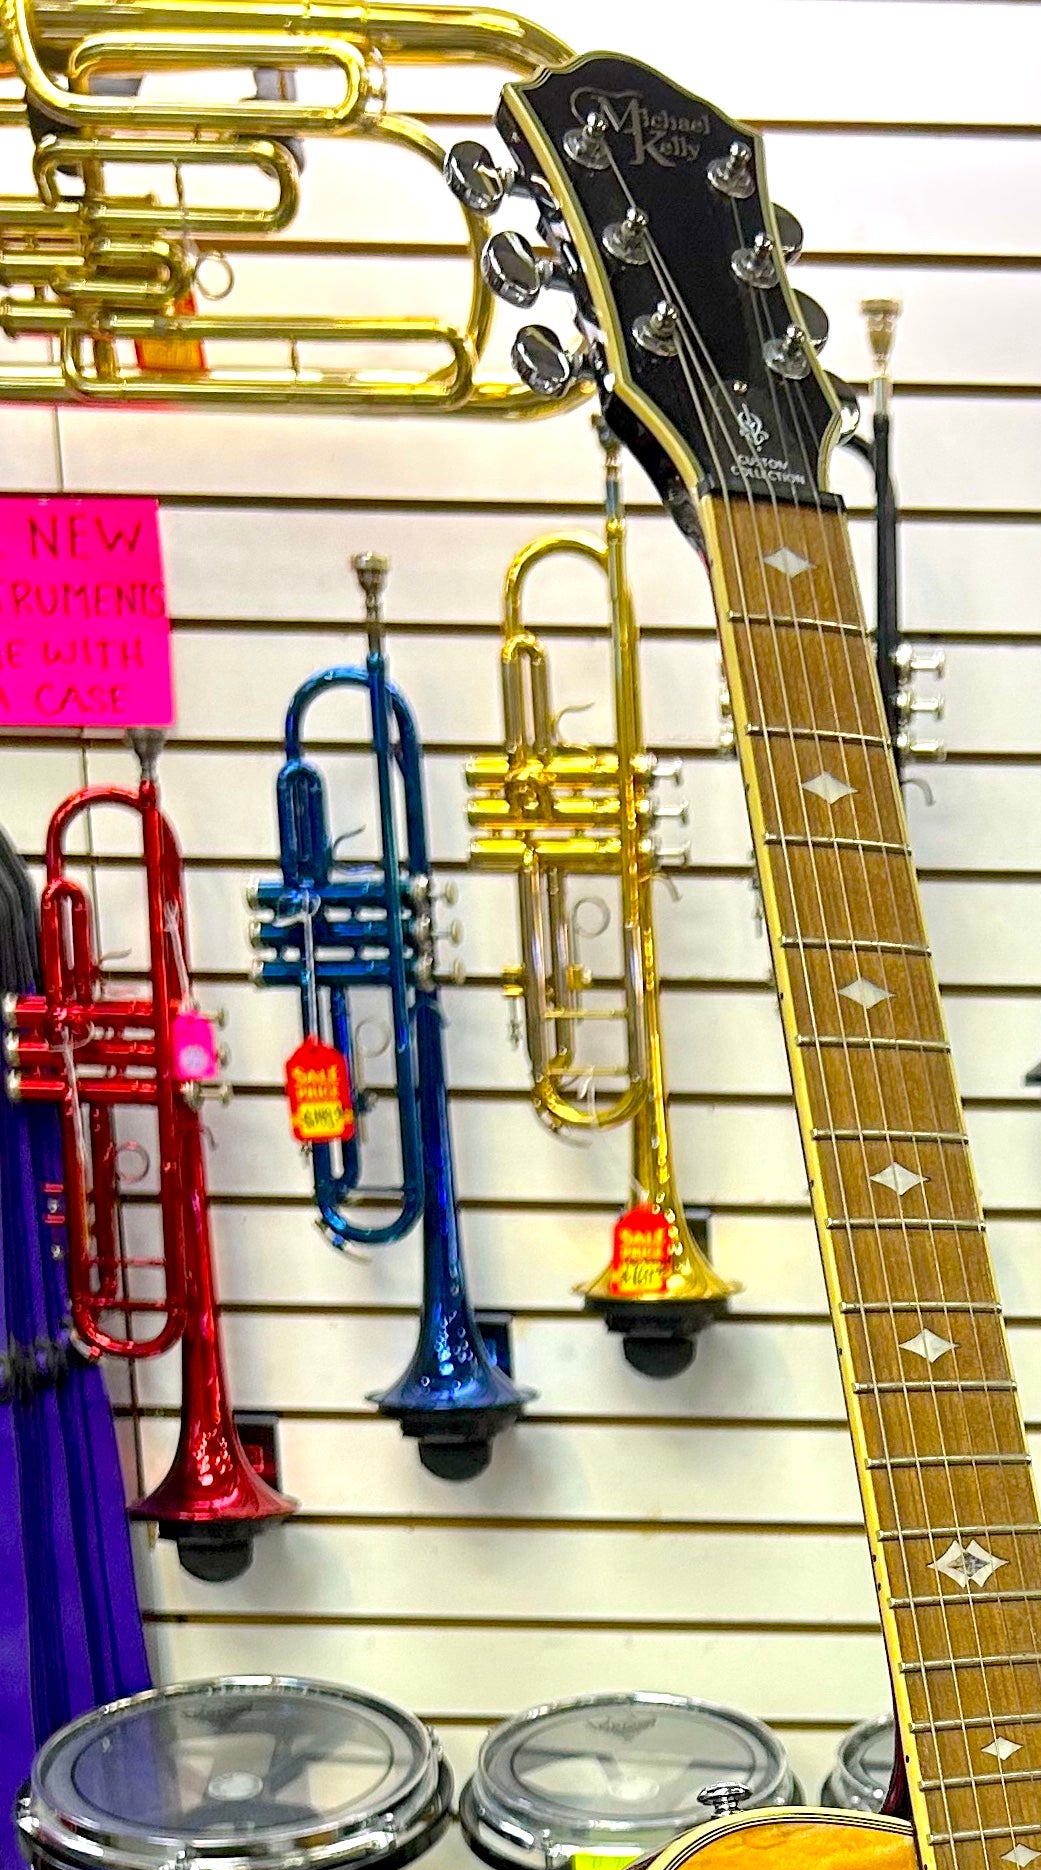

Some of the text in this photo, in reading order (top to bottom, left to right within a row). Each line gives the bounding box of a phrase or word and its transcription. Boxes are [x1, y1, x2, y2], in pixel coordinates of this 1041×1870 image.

[571, 87, 711, 135] Michael
[628, 128, 700, 168] Kelly
[730, 466, 806, 485] COLLECTION
[28, 514, 142, 559] NEW
[42, 635, 144, 672] WITH
[35, 681, 129, 717] CASE
